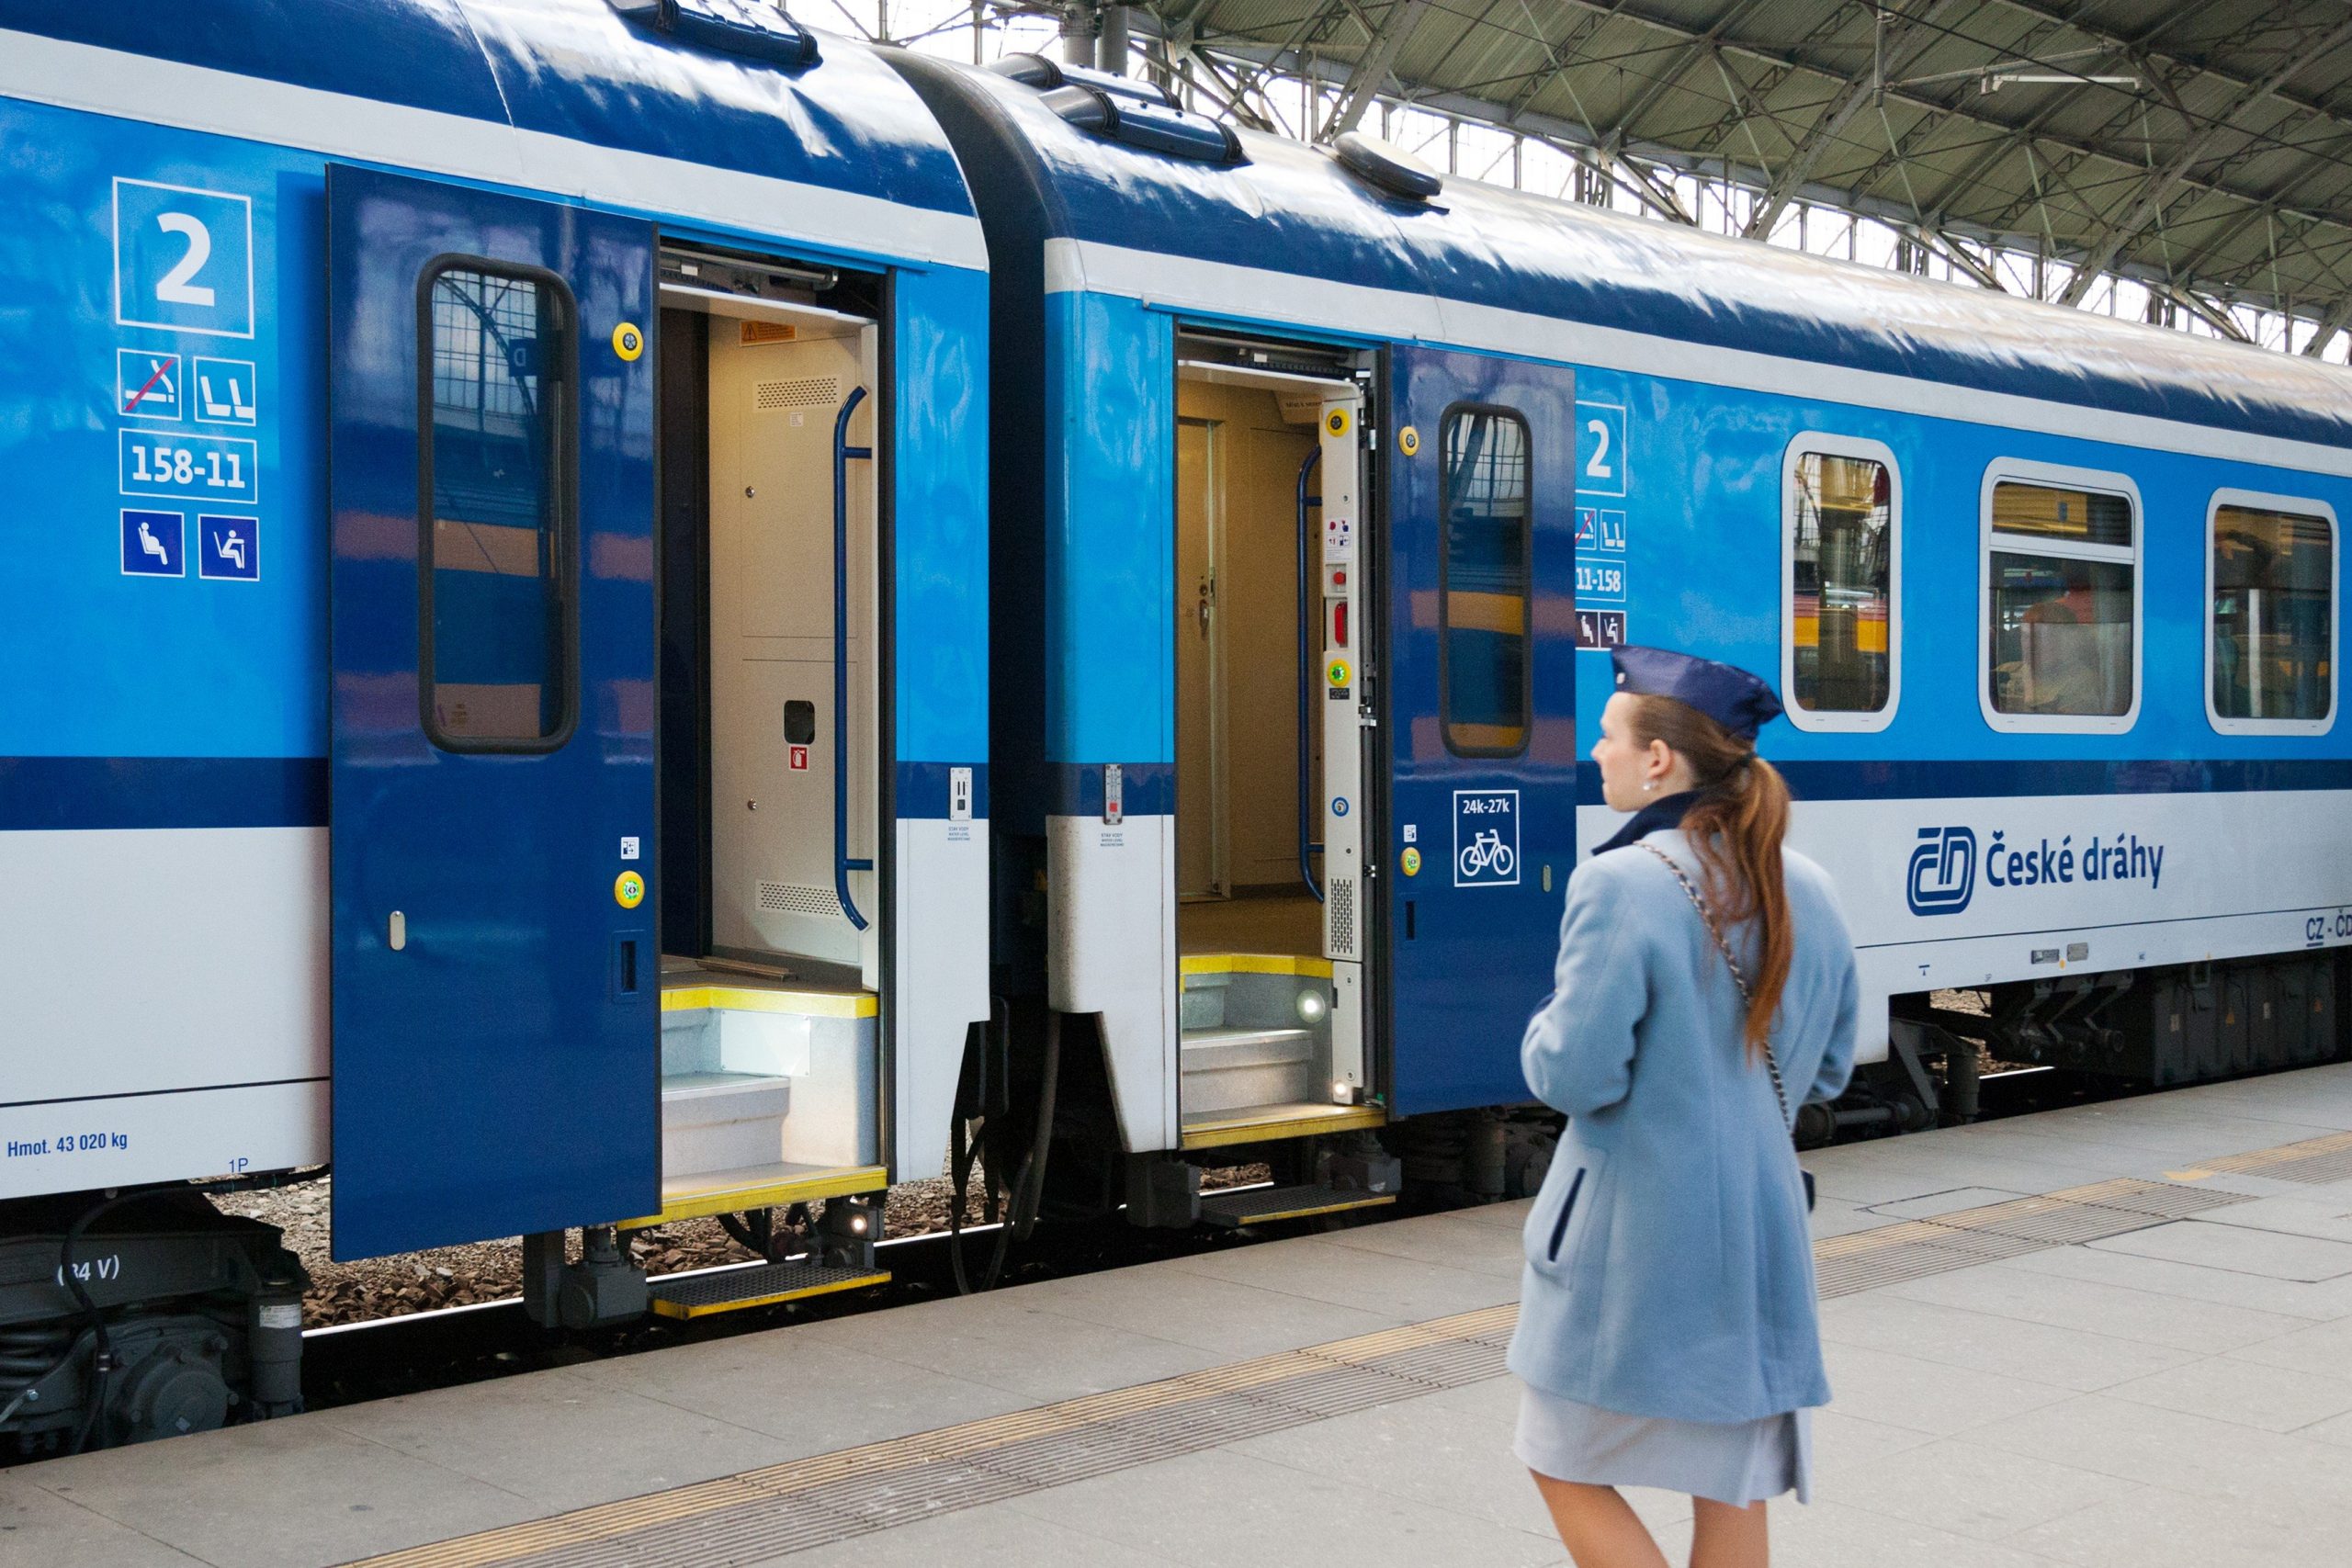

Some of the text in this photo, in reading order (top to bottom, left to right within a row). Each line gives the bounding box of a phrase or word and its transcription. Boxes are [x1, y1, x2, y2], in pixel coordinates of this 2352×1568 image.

[156, 212, 215, 307] 2
[1587, 419, 1611, 479] 2
[132, 446, 246, 489] 158-11
[1576, 567, 1622, 593] 11-158
[1463, 798, 1510, 814] 24k-27k
[1985, 829, 2165, 889] České dráhy
[2306, 917, 2324, 942] CZ
[7, 1132, 128, 1157] Hmot. 43 020 kg
[228, 1157, 249, 1173] 1P
[97, 1254, 120, 1280] V)
